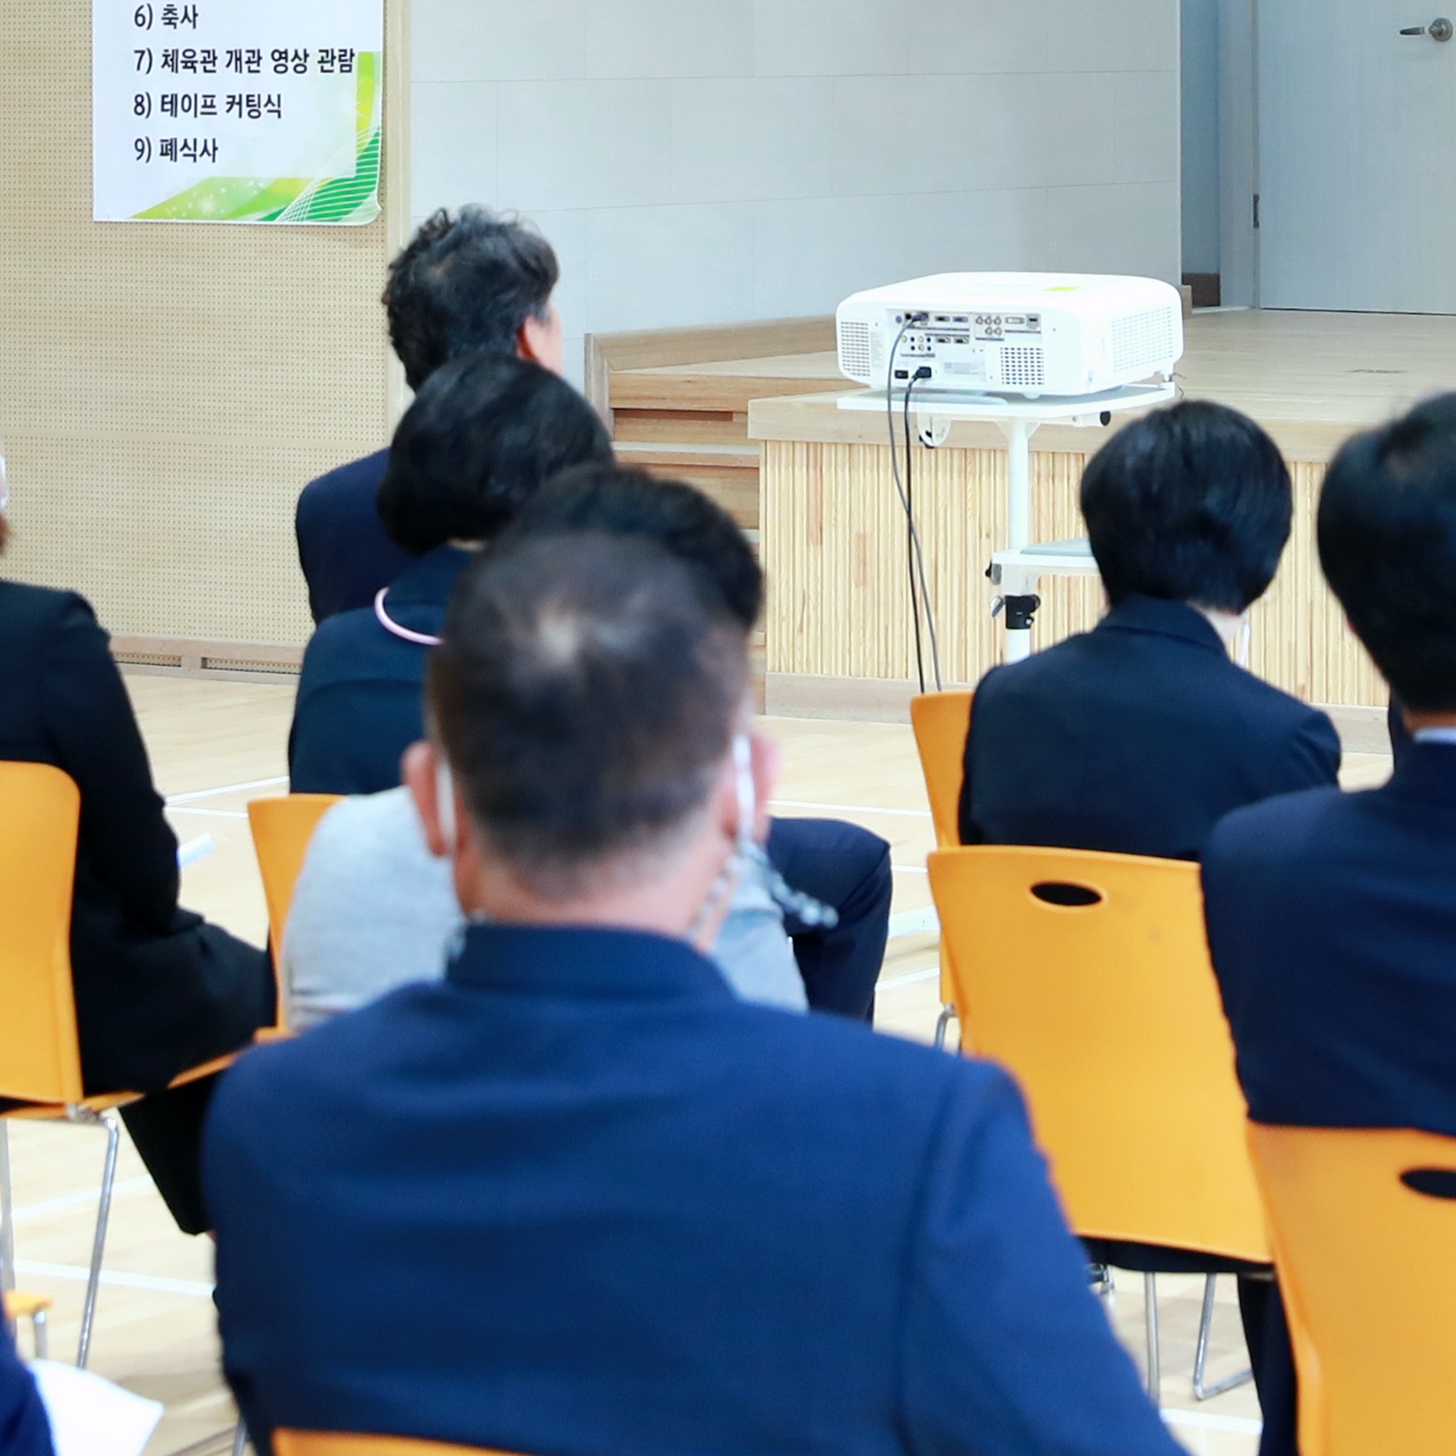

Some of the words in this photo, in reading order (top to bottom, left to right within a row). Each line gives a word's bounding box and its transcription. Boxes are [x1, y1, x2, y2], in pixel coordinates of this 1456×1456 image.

[134, 3, 153, 30] 6)
[161, 4, 199, 30] 축사
[134, 48, 153, 75] 7)
[161, 48, 218, 74] 체육관
[225, 49, 263, 74] 개관
[270, 48, 310, 74] 영상
[317, 48, 355, 74] 관람
[133, 92, 152, 119] 8)
[160, 93, 217, 118] 테이프
[226, 93, 282, 119] 커팅식
[134, 137, 152, 163] 9)
[159, 138, 218, 163] 폐식사
